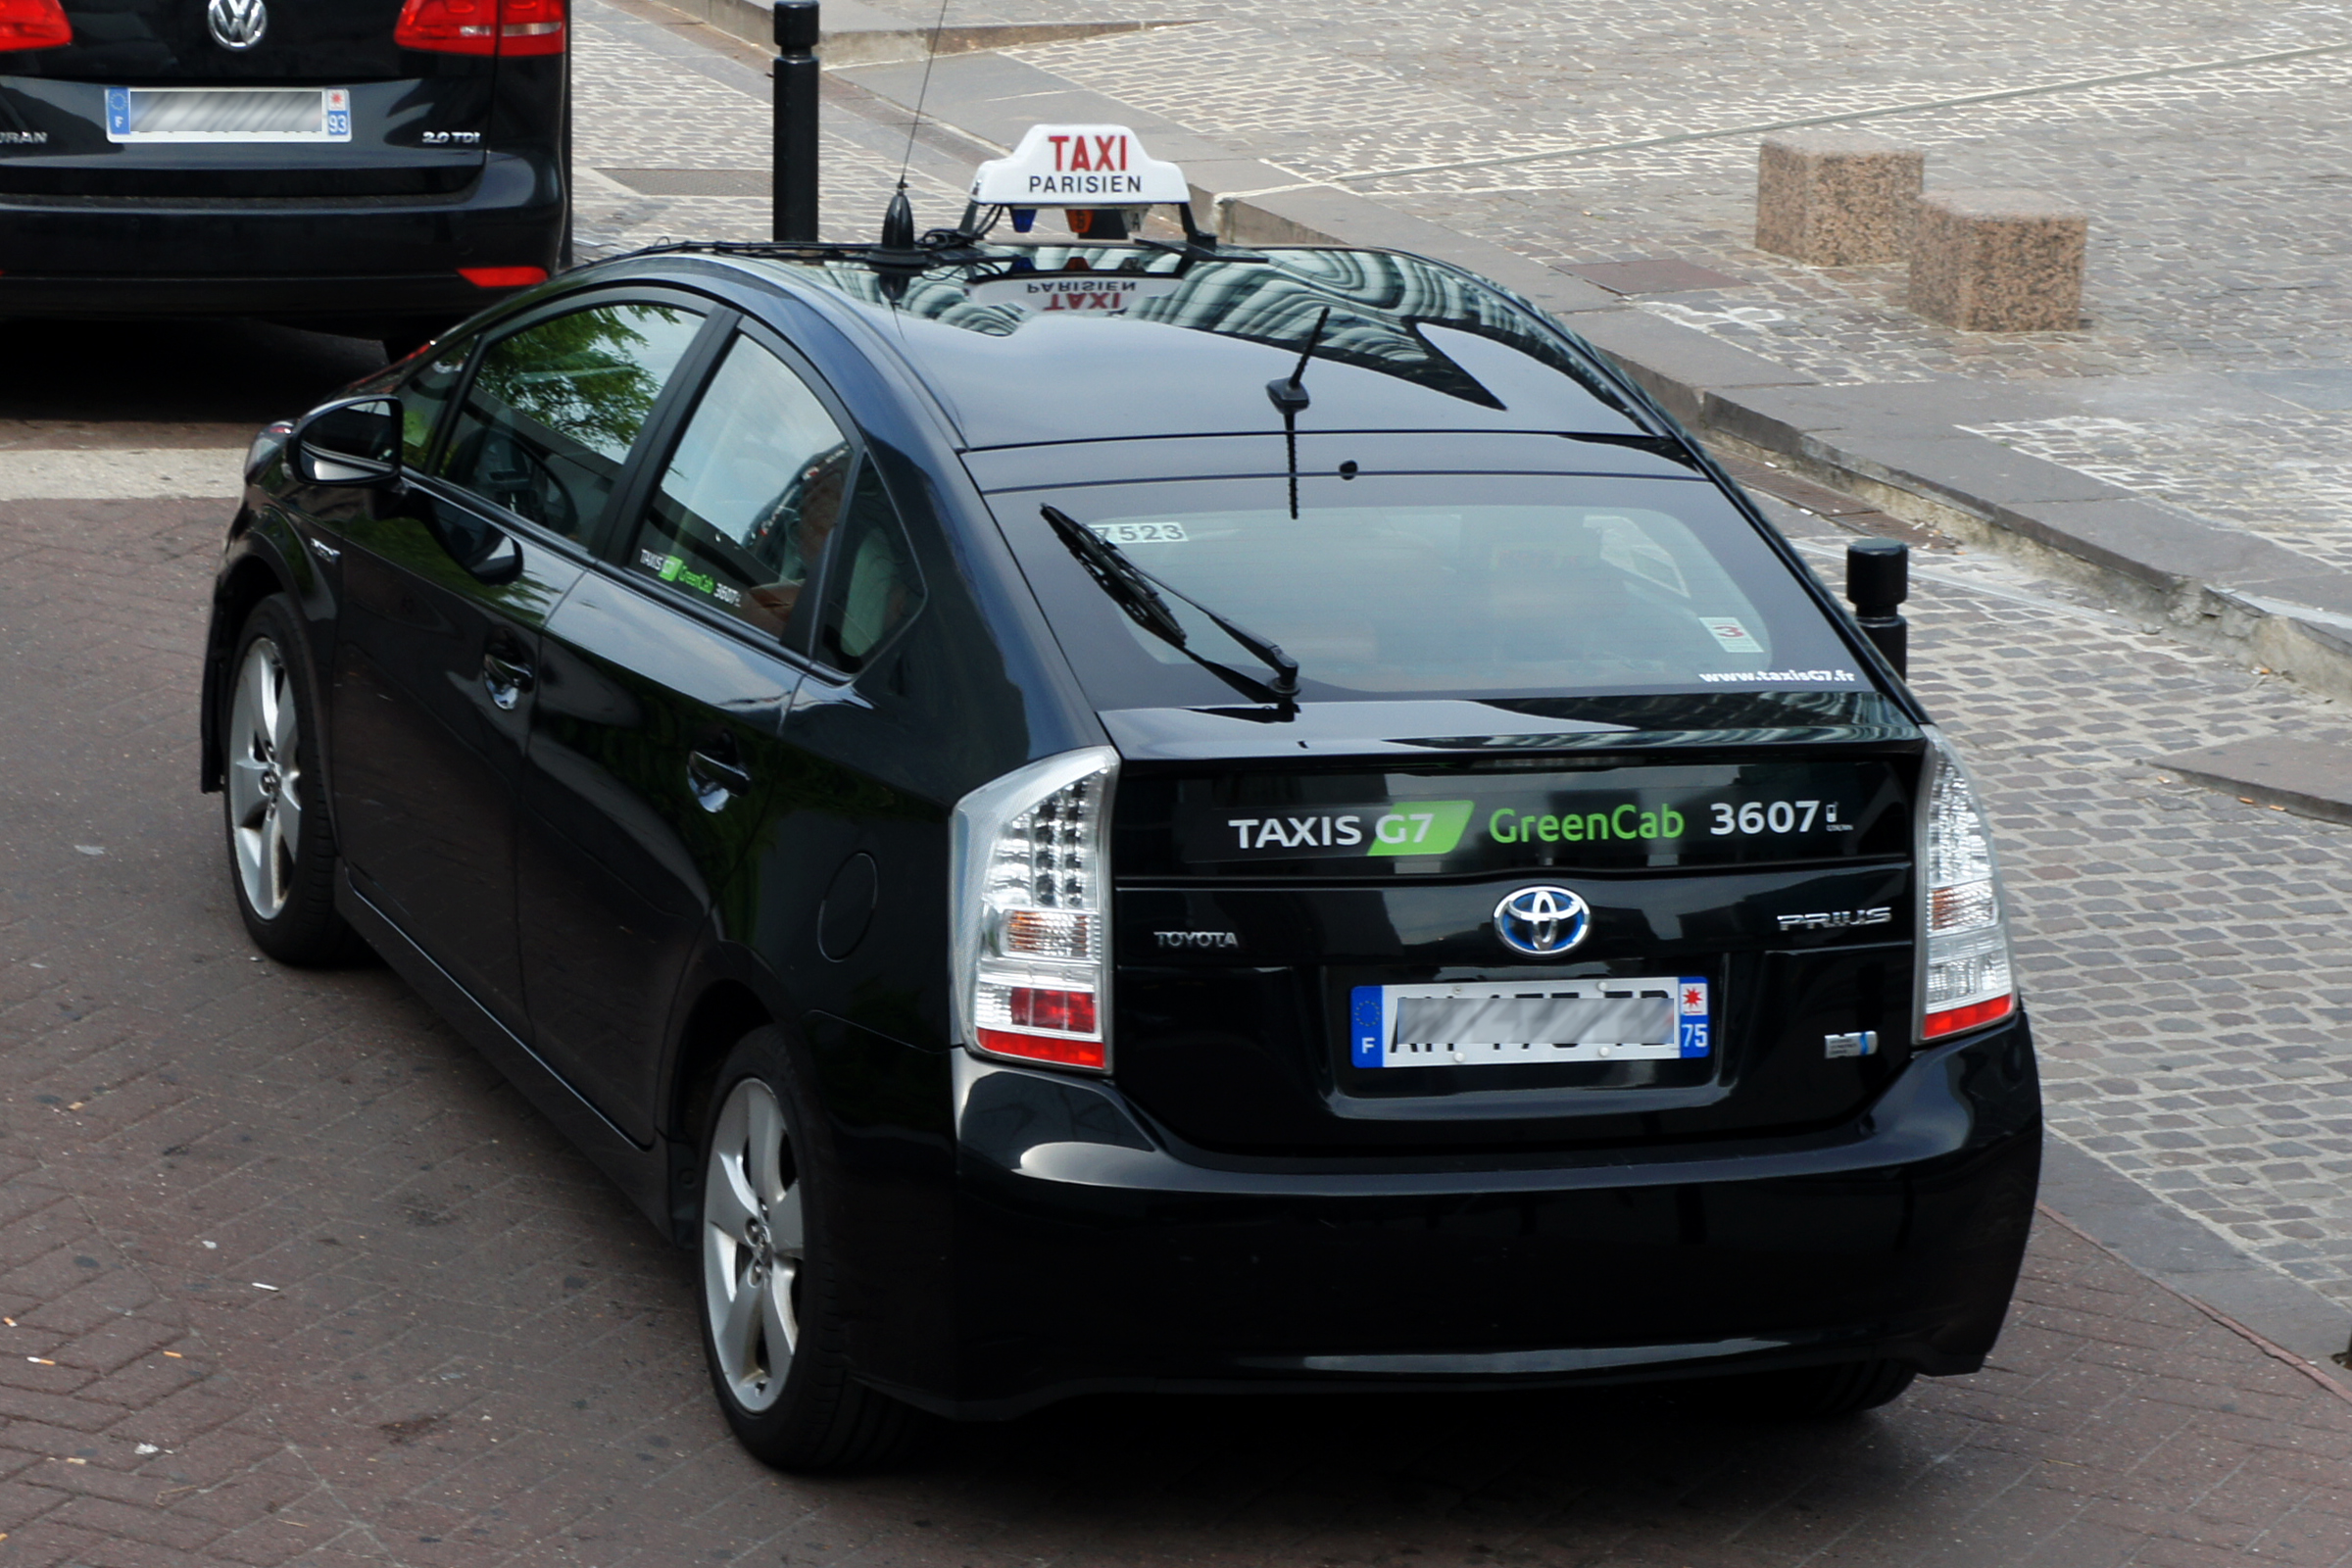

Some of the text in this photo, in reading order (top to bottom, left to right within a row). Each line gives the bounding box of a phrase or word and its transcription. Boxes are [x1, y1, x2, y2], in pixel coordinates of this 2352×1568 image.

[115, 116, 123, 127] F
[328, 114, 347, 133] 93
[451, 131, 481, 143] TDI
[1049, 135, 1127, 172] TAXI
[1029, 175, 1142, 193] PARISIEN
[1132, 213, 1141, 230] A
[1713, 625, 1744, 637] 3
[1698, 669, 1855, 682] www.taxisG7.fr
[1228, 800, 1820, 849] TAXIS G7 GreenCab 3607
[1777, 906, 1891, 931] PRIUS
[1153, 931, 1238, 948] TOYOTA
[1681, 1023, 1708, 1048] 75
[1362, 1037, 1375, 1054] F
